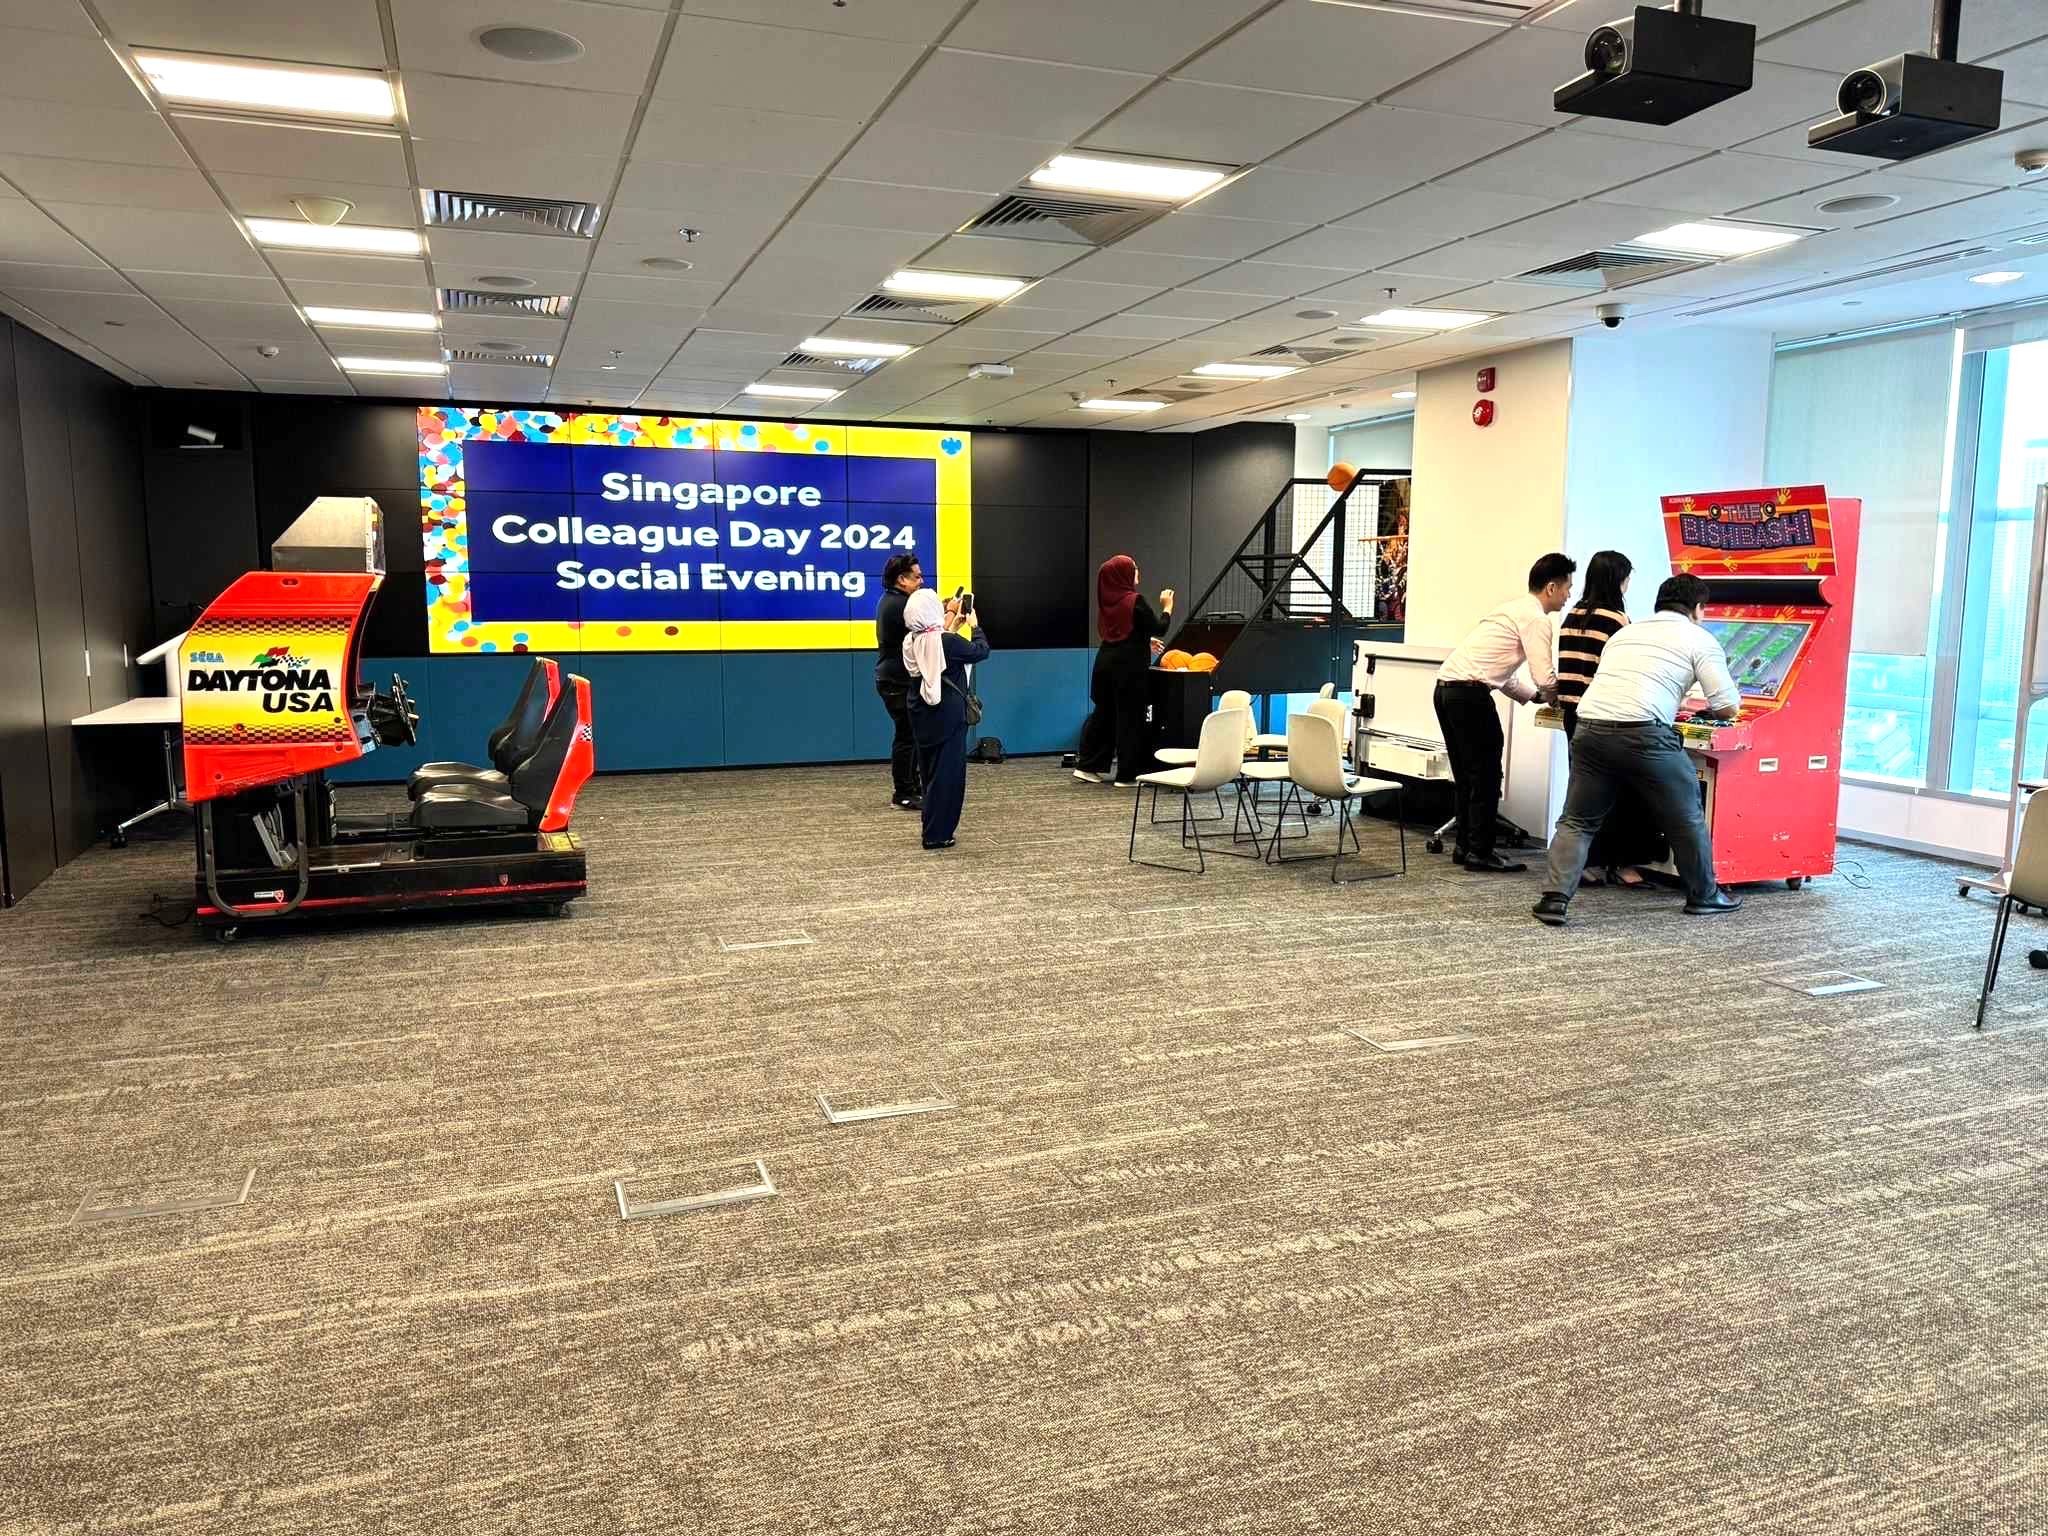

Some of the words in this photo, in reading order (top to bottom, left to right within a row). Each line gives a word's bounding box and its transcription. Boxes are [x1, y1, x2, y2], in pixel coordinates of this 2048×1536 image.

[602, 472, 822, 511] Singapore
[1722, 503, 1762, 521] THE
[491, 515, 720, 553] Colleague
[729, 521, 809, 555] Day
[819, 523, 916, 550] 2024
[1681, 511, 1814, 549] BISHIBASHI
[556, 560, 690, 590] Social
[700, 563, 866, 597] Evening
[190, 651, 224, 663] SEGA
[187, 669, 332, 691] DAYTONA
[262, 692, 334, 713] USA
